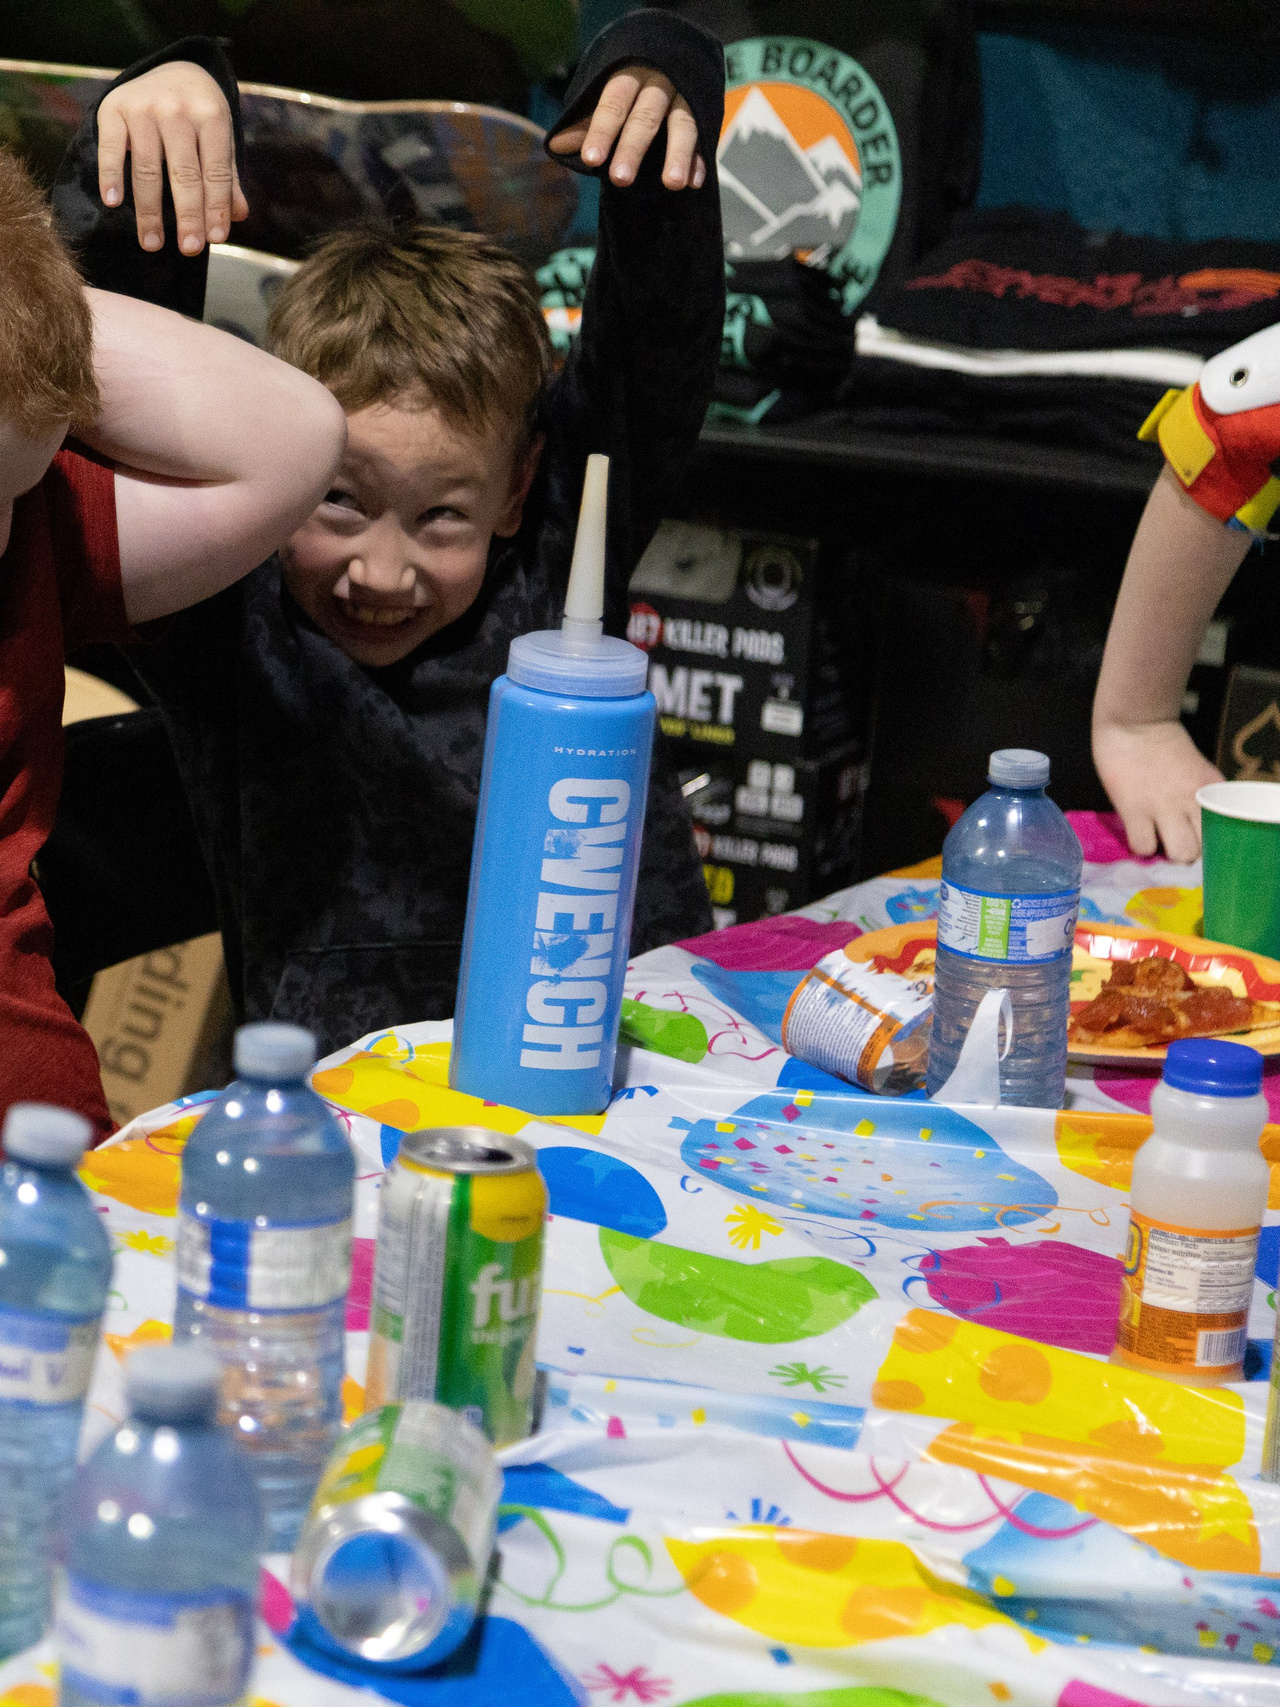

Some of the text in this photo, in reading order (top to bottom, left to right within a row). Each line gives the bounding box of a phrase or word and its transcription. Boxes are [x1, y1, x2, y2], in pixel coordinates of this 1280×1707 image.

[761, 44, 893, 188] BOARDER
[664, 617, 730, 660] KILLER
[731, 626, 785, 666] PADS
[554, 745, 637, 757] HYDRATION
[520, 778, 631, 1070] CWENCH
[1150, 1233, 1179, 1246] Nutrition
[1180, 1240, 1200, 1250] Facts
